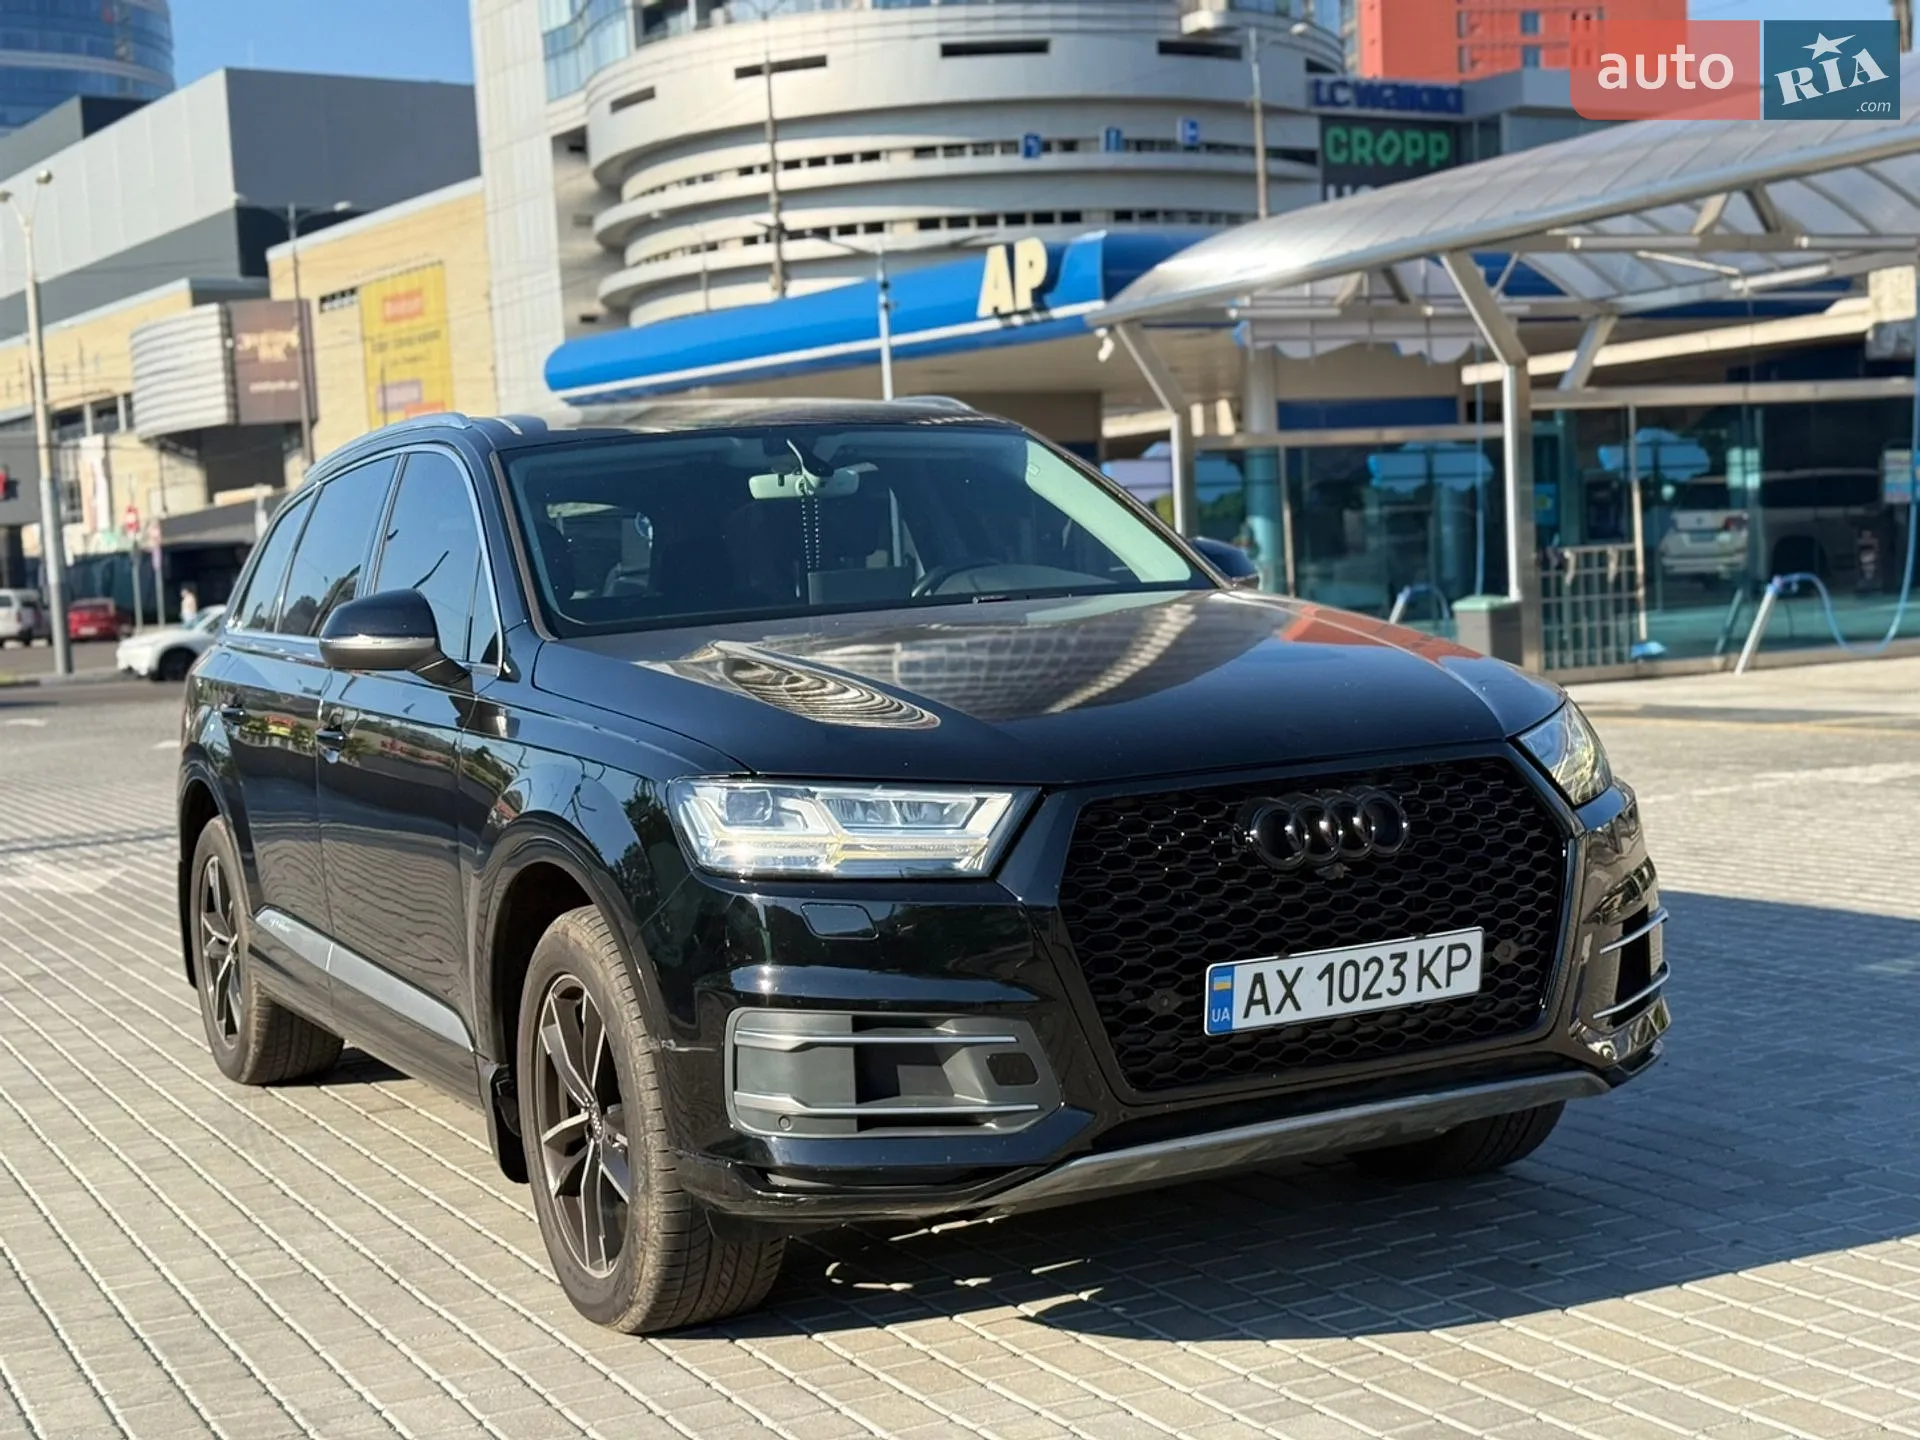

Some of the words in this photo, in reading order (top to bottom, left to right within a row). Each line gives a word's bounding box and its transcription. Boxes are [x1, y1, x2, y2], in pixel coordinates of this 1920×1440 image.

[1325, 125, 1450, 168] CROPP
[977, 236, 1048, 318] AP
[1242, 966, 1304, 1019] AX
[1316, 951, 1408, 1006] 1023
[1416, 942, 1473, 992] KP
[1211, 1006, 1231, 1023] UA
